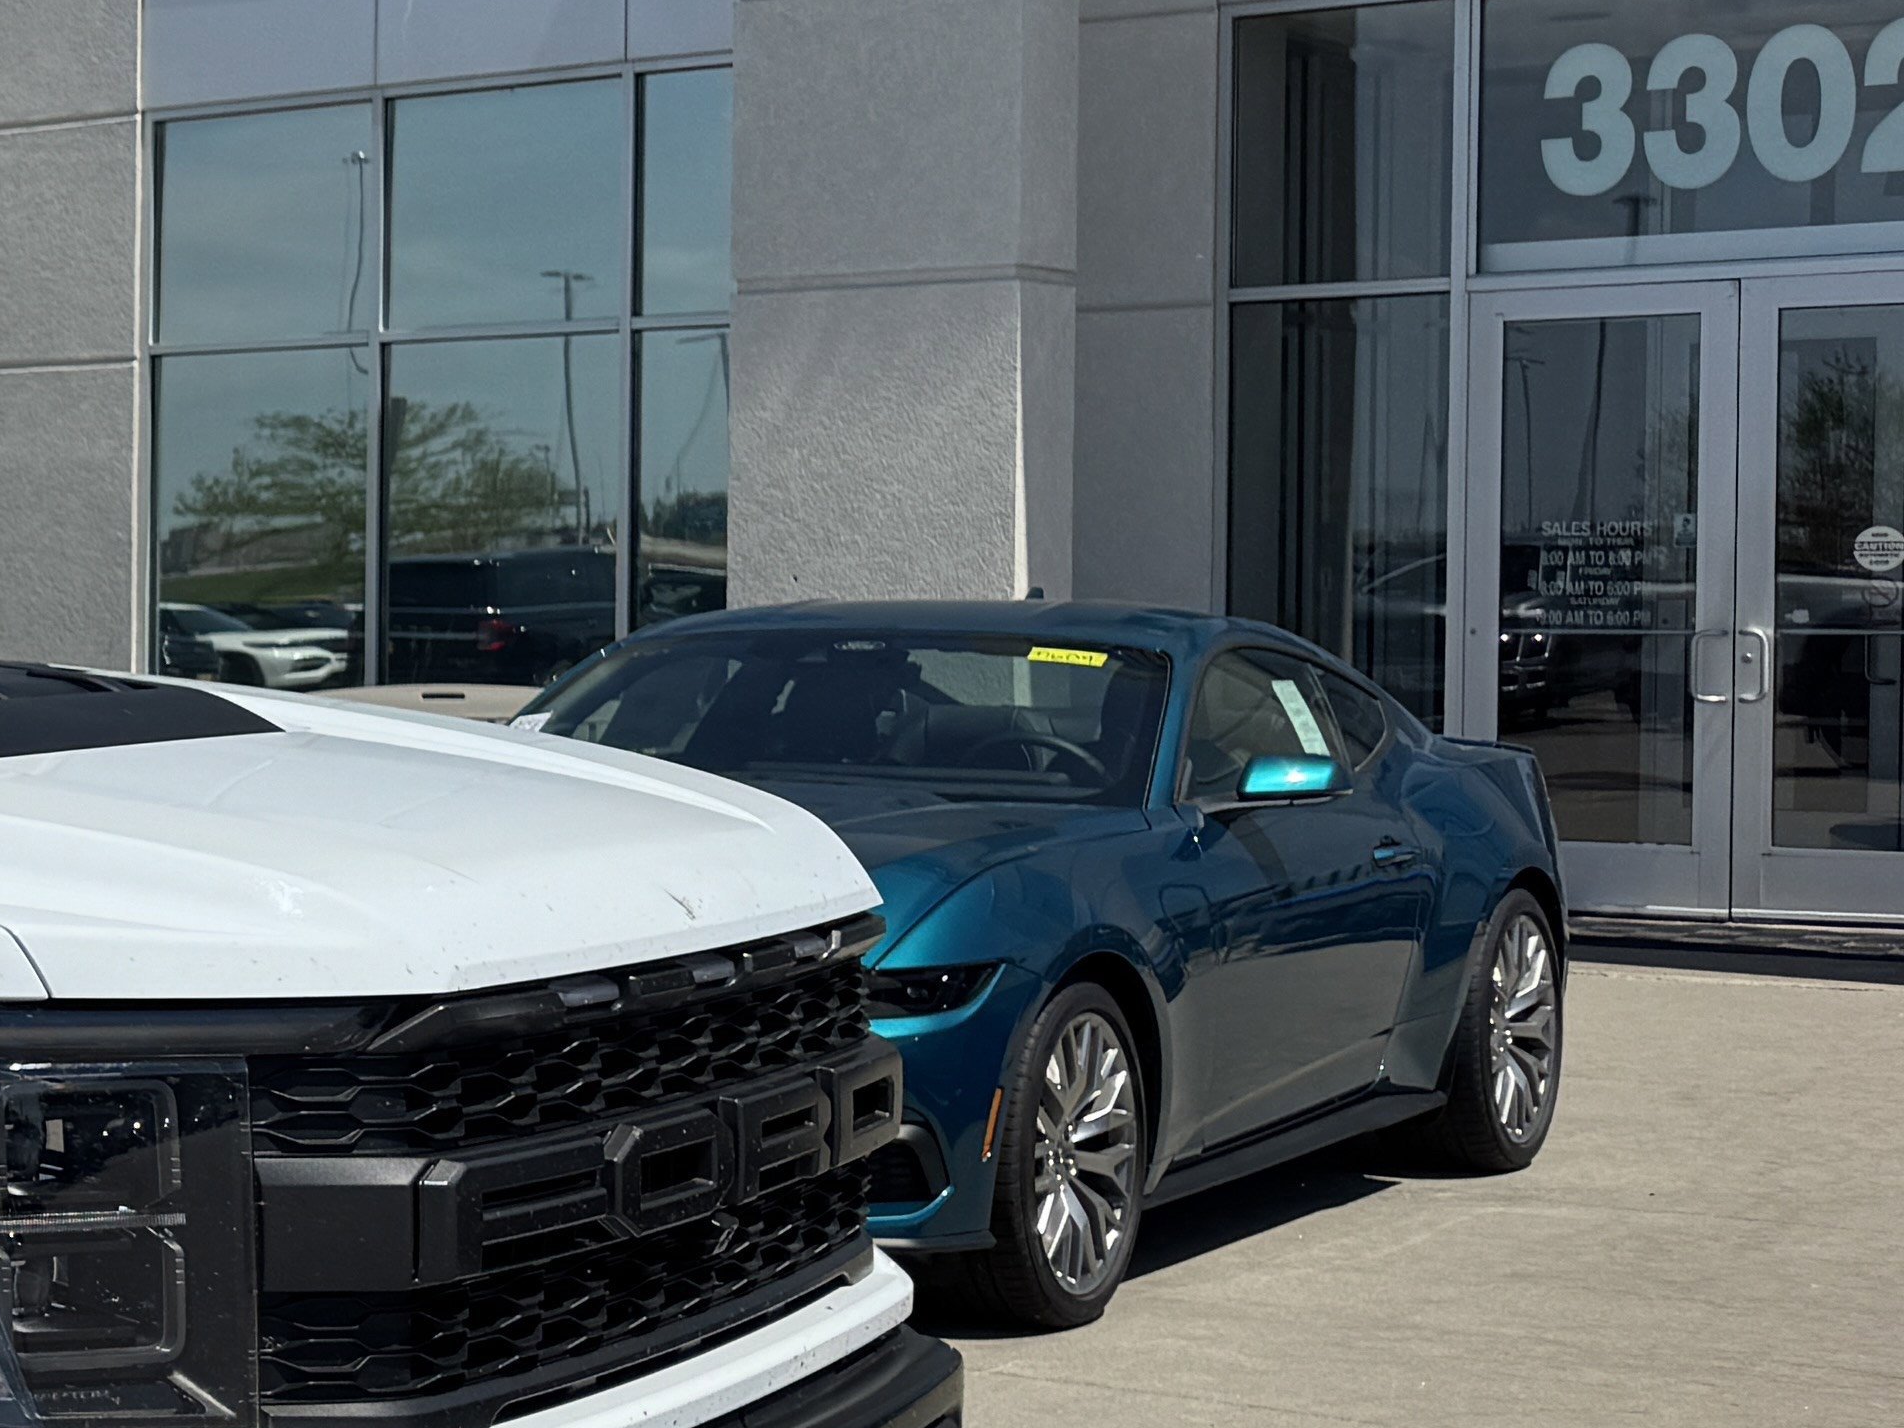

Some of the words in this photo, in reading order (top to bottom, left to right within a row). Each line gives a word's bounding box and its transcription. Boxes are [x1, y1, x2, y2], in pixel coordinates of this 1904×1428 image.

[1541, 520, 1591, 537] SALES
[1596, 520, 1653, 537] HOURS
[1568, 550, 1586, 566] AM
[1589, 550, 1605, 566] TO
[1566, 580, 1585, 596] AM
[1588, 580, 1604, 596] TO
[1565, 609, 1584, 626] AM
[1588, 609, 1604, 626] TO
[1633, 609, 1652, 626] PM
[416, 1040, 904, 1283] FORD
